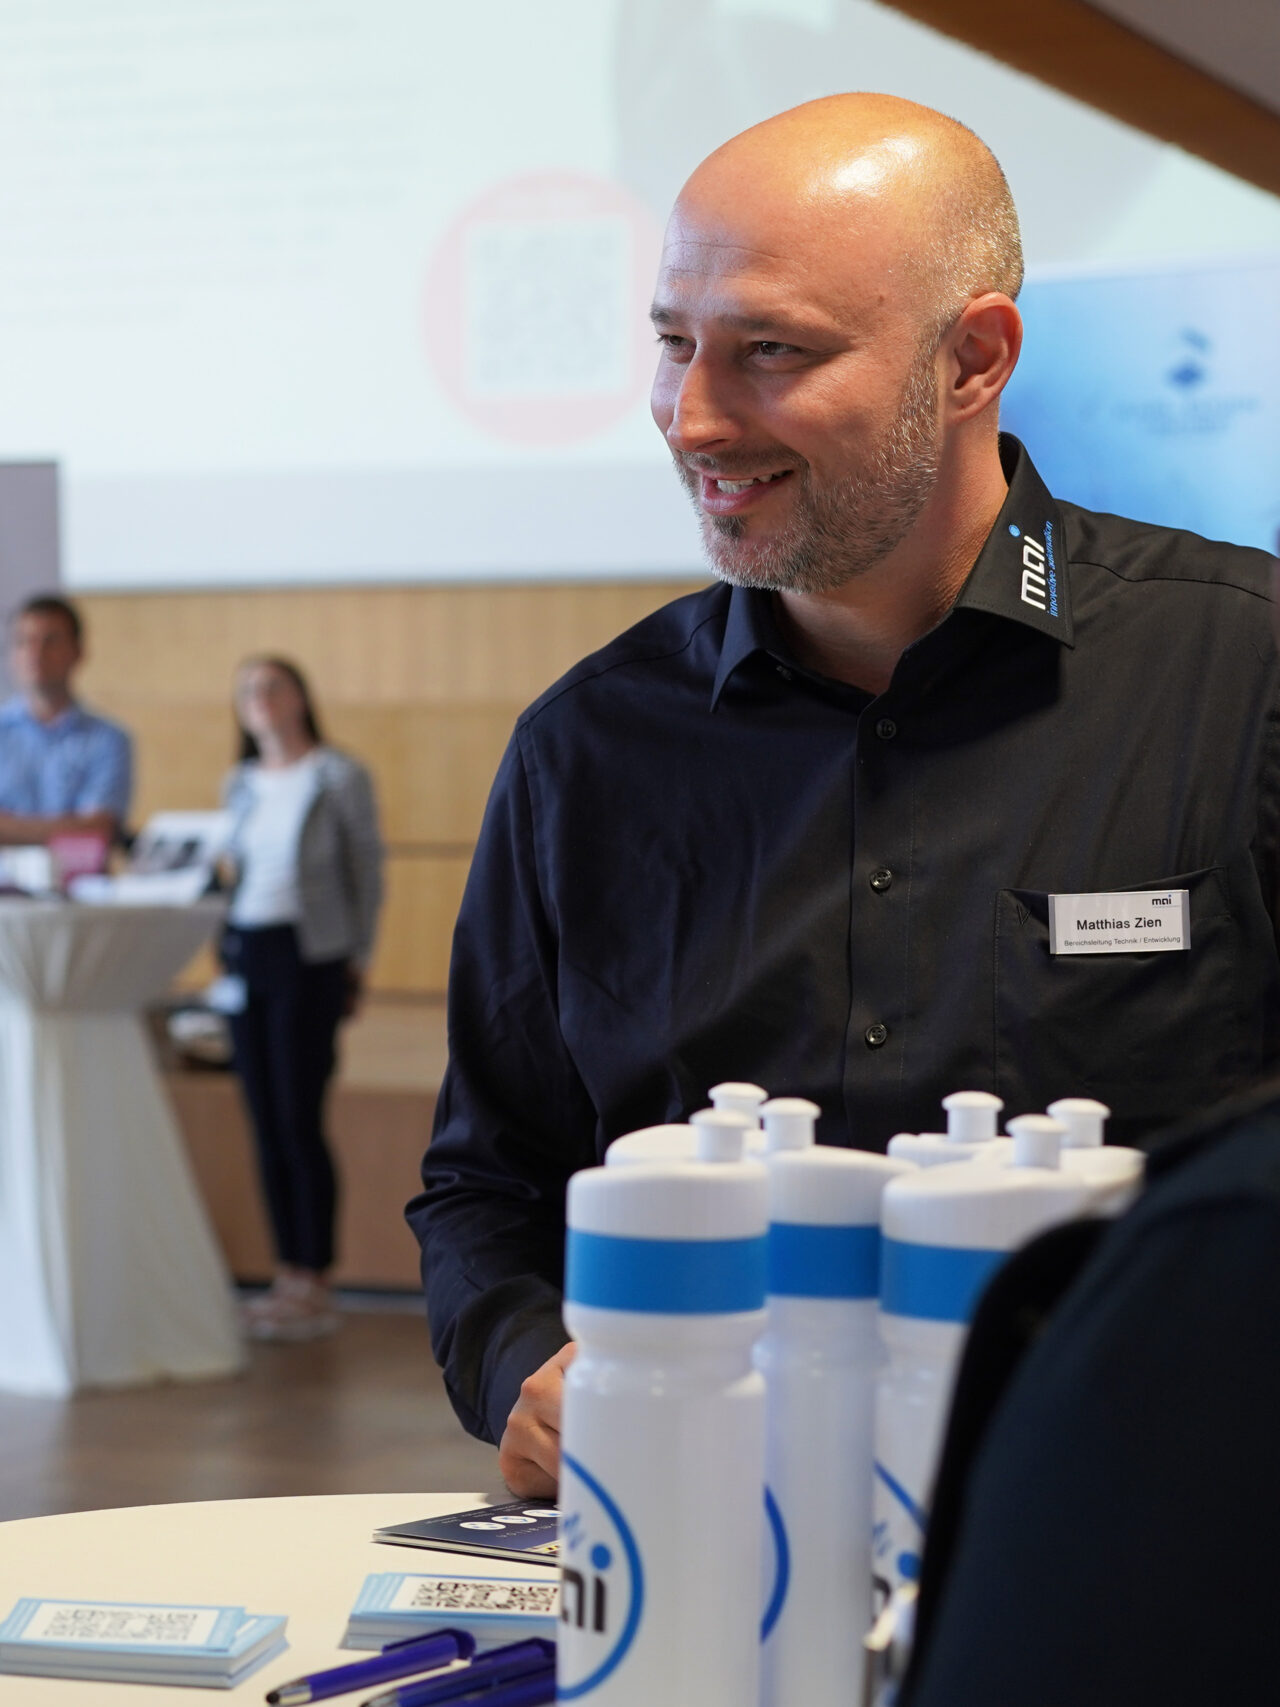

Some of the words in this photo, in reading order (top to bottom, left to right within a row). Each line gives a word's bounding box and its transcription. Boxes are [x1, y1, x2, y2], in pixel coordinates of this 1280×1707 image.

[1047, 570, 1058, 616] innovative
[1076, 919, 1130, 930] Matthias
[1135, 918, 1162, 928] Zien
[1064, 938, 1112, 947] Bereichsleitung
[1114, 937, 1138, 945] Technik
[1143, 935, 1181, 944] Entwicklung
